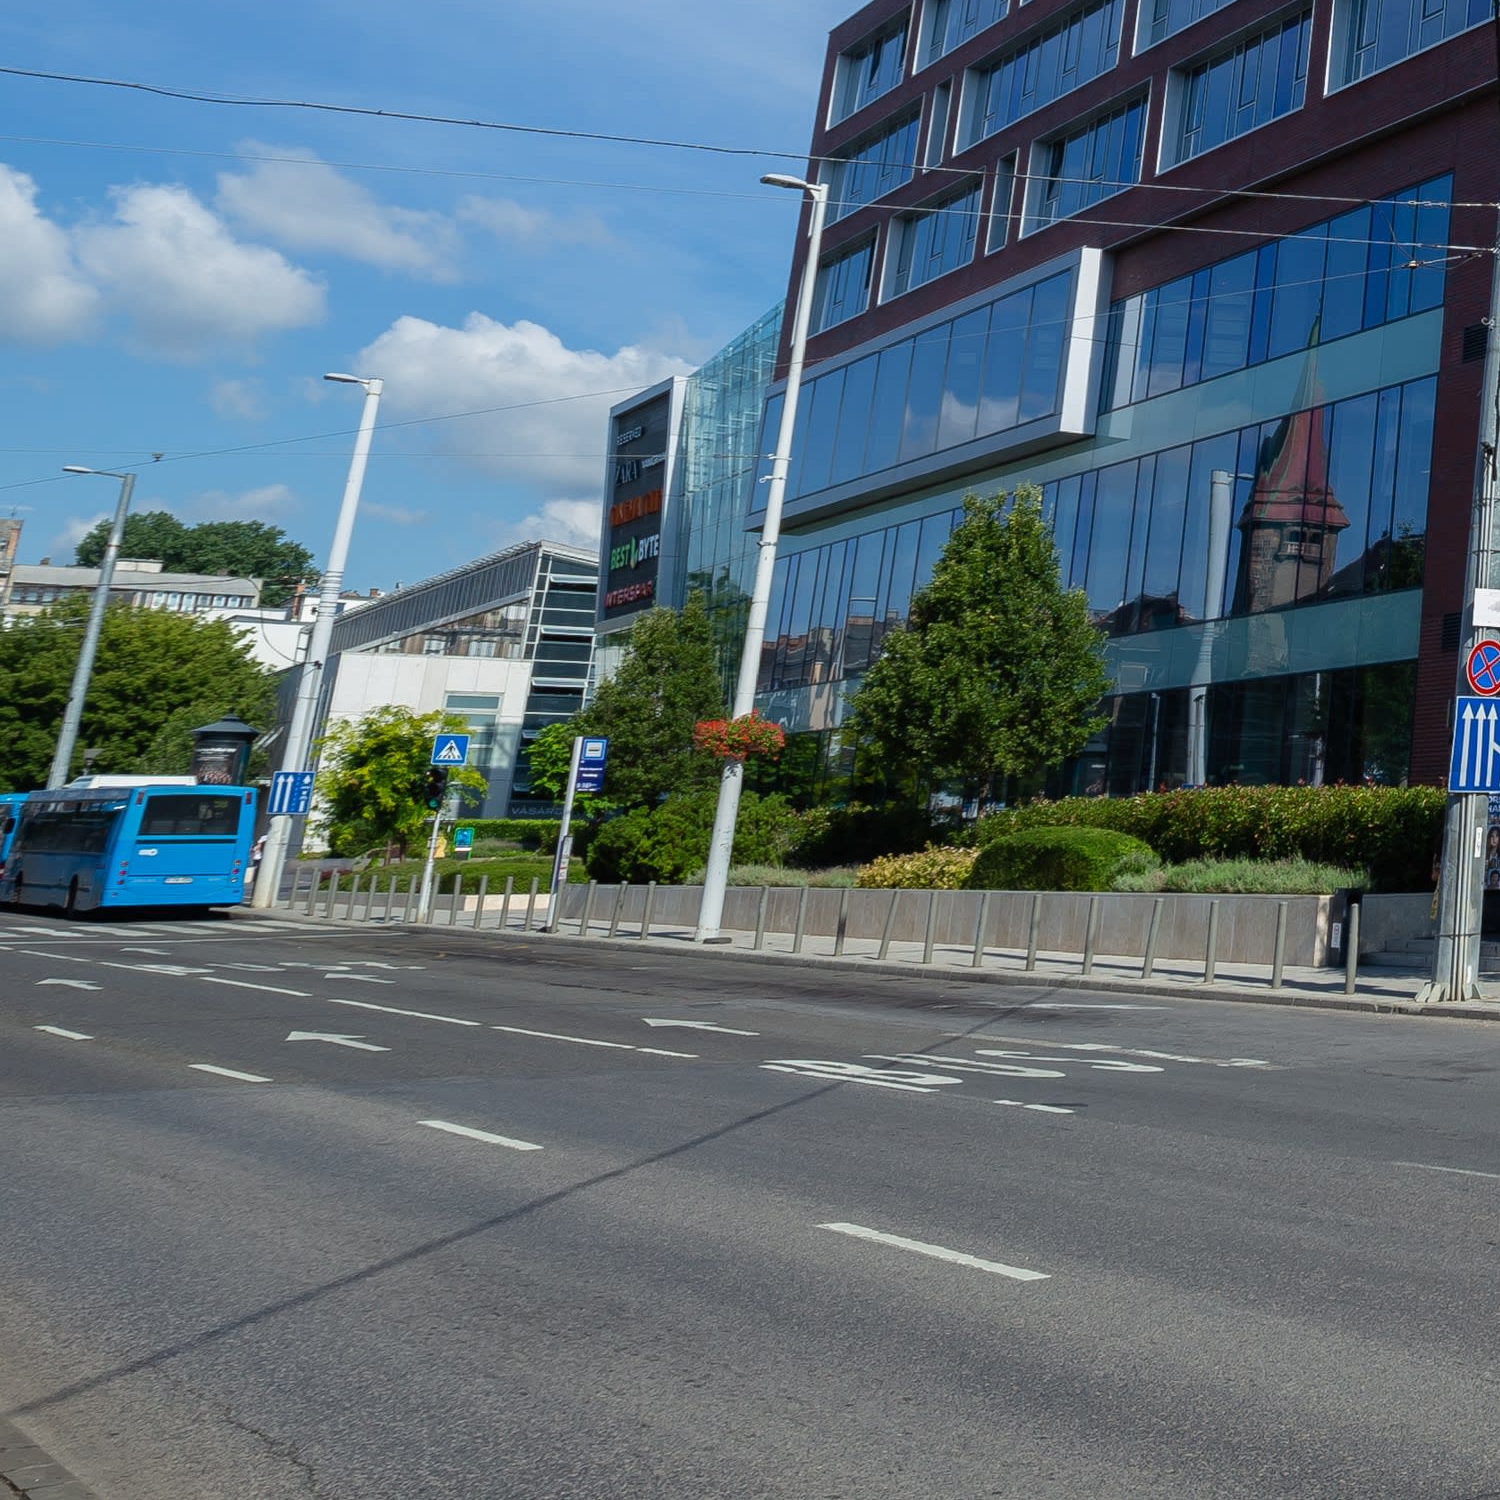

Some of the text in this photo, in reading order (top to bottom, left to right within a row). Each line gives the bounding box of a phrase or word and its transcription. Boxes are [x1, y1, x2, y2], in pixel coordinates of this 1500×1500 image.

[616, 460, 638, 486] ZARA
[610, 534, 659, 570] BEST BYTE
[757, 1049, 1165, 1093] BUS
